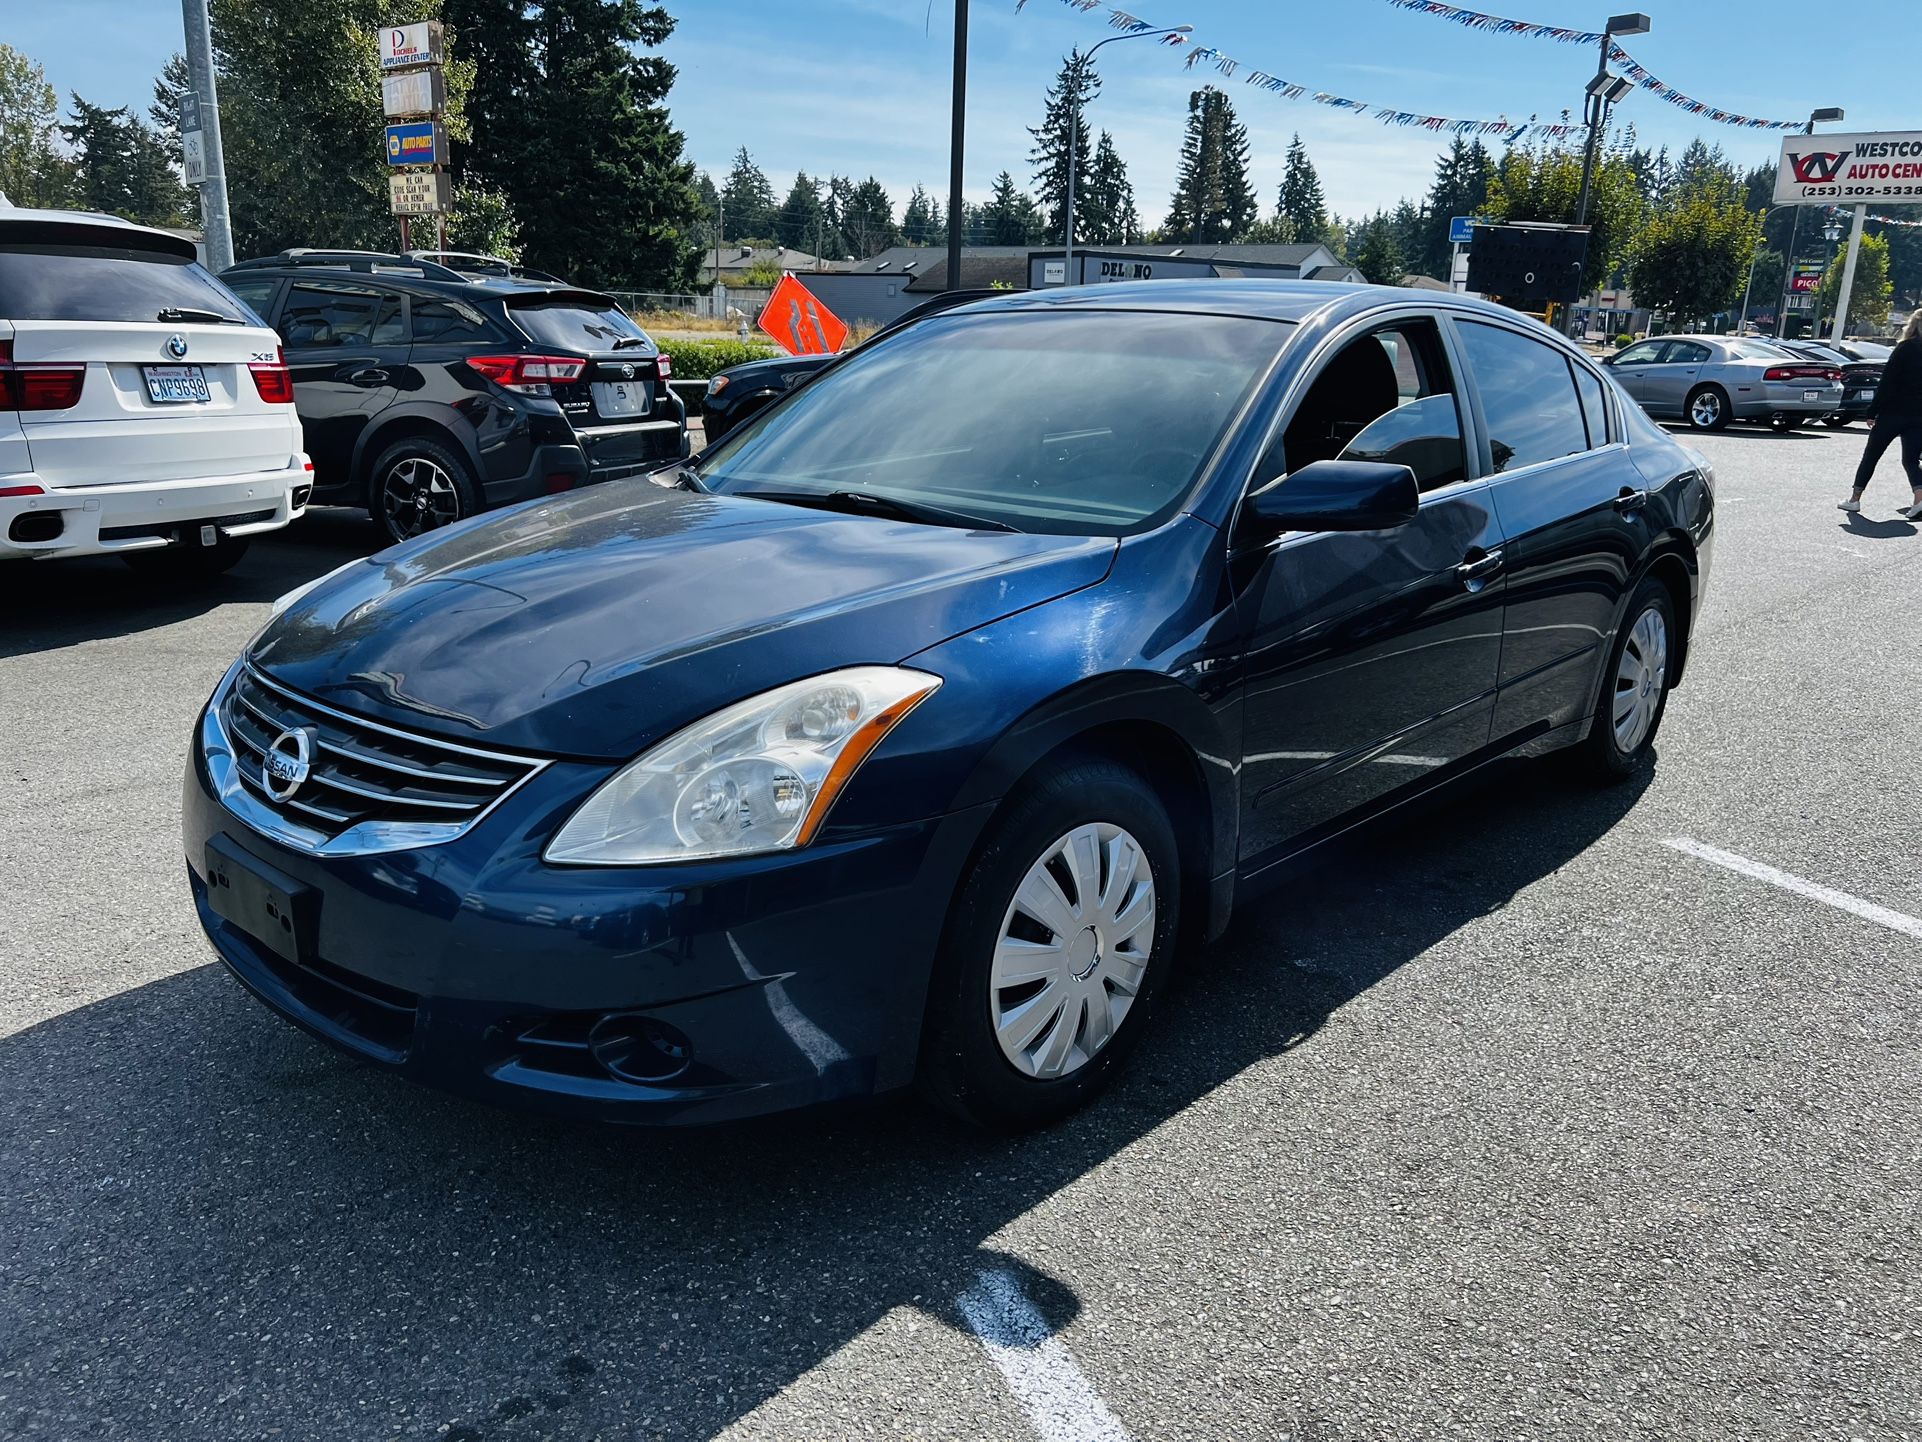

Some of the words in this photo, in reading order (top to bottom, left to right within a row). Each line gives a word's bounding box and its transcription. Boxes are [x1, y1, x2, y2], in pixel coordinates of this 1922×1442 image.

[383, 54, 410, 66] APPLIANCE
[410, 52, 430, 62] CENTER
[402, 136, 415, 150] AUTO
[415, 135, 432, 148] PARTS
[1855, 141, 1922, 158] WESTCO
[1847, 163, 1890, 179] AUTO
[1802, 185, 1842, 197] (253)
[1844, 186, 1922, 195] 302-5338
[150, 378, 206, 397] CNP9698
